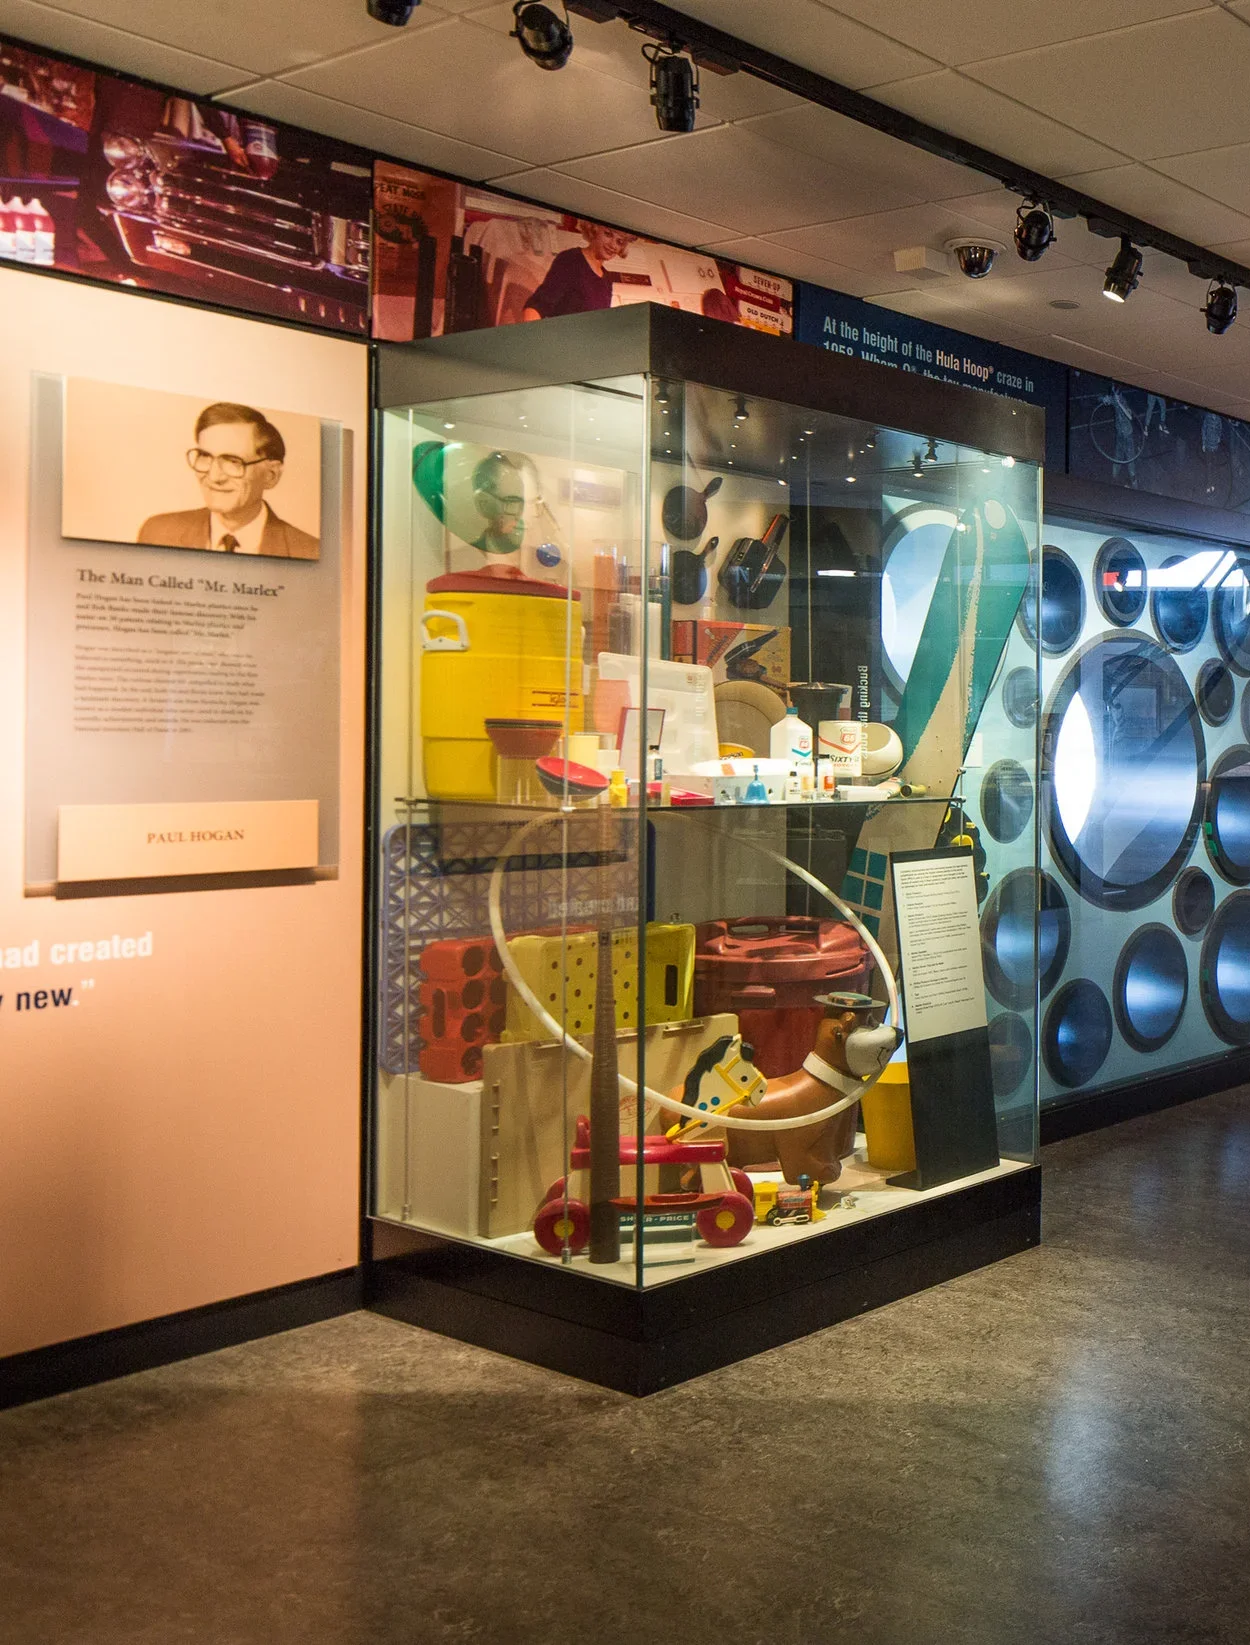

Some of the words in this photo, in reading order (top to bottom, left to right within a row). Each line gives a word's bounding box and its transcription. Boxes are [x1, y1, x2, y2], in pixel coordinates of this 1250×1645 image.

[824, 316, 837, 334] At
[840, 320, 859, 341] the
[863, 327, 898, 353] height
[901, 341, 913, 357] of
[915, 342, 933, 363] the
[936, 349, 960, 372] Hula
[997, 370, 1023, 390] craze
[1025, 376, 1035, 393] in
[77, 568, 106, 585] The
[110, 571, 144, 587] Man
[148, 574, 194, 591] Called
[147, 831, 187, 845] PAUL
[190, 829, 245, 843] HOGAN
[50, 931, 154, 965] created
